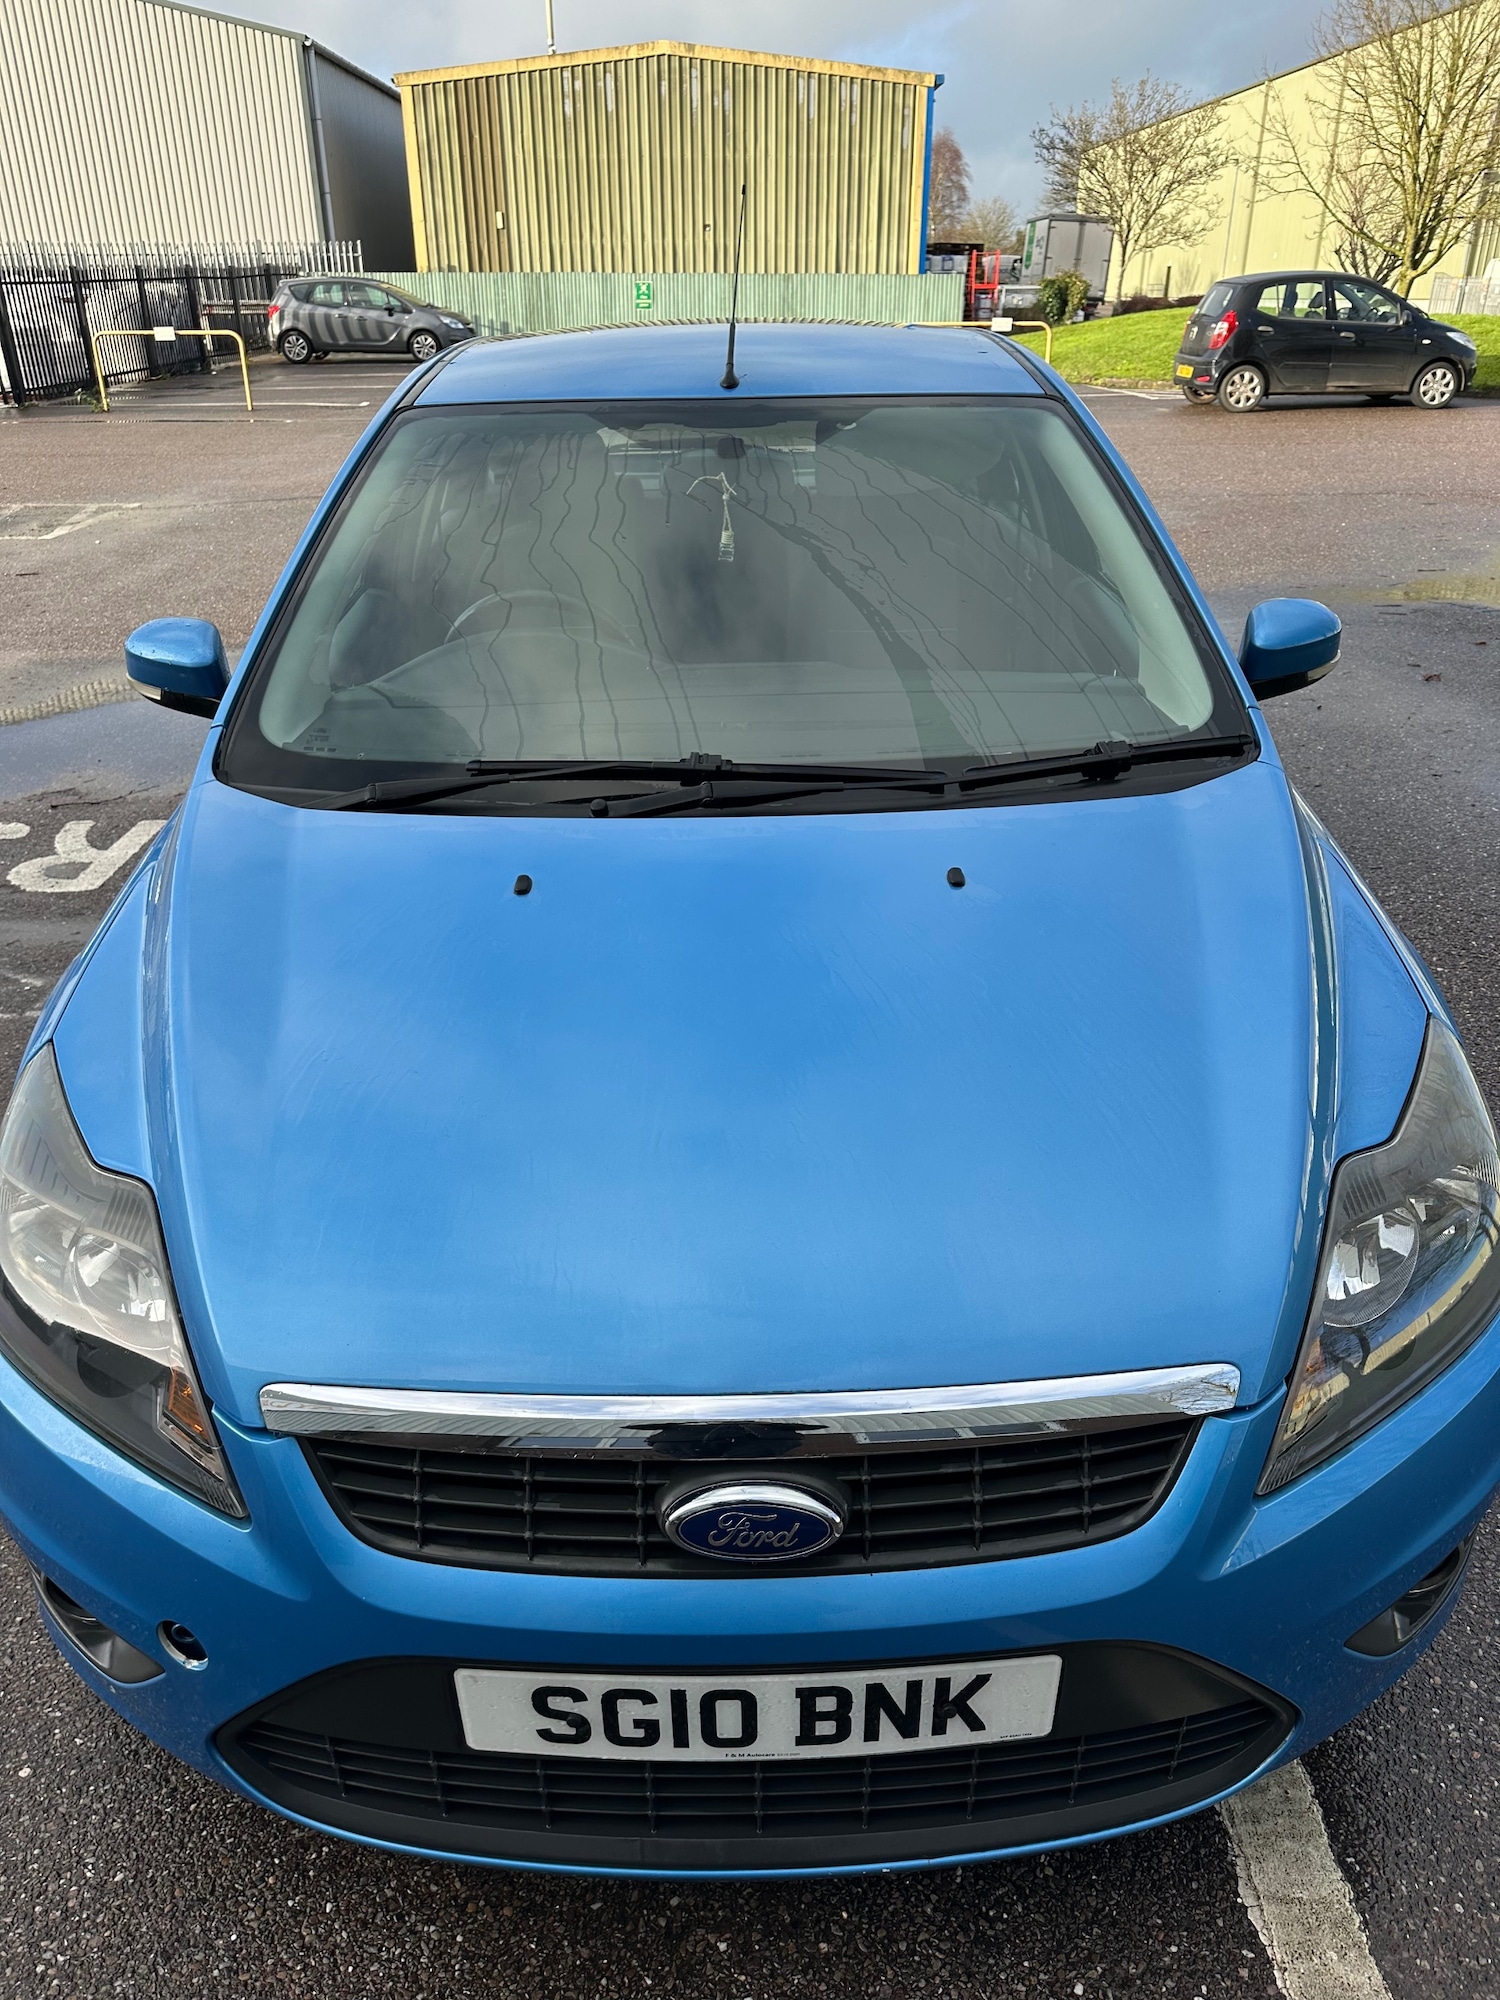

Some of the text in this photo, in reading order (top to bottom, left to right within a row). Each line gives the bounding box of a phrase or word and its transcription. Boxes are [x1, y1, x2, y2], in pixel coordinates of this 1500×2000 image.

[707, 1512, 800, 1548] Ford
[530, 1673, 993, 1749] SG10 BNK
